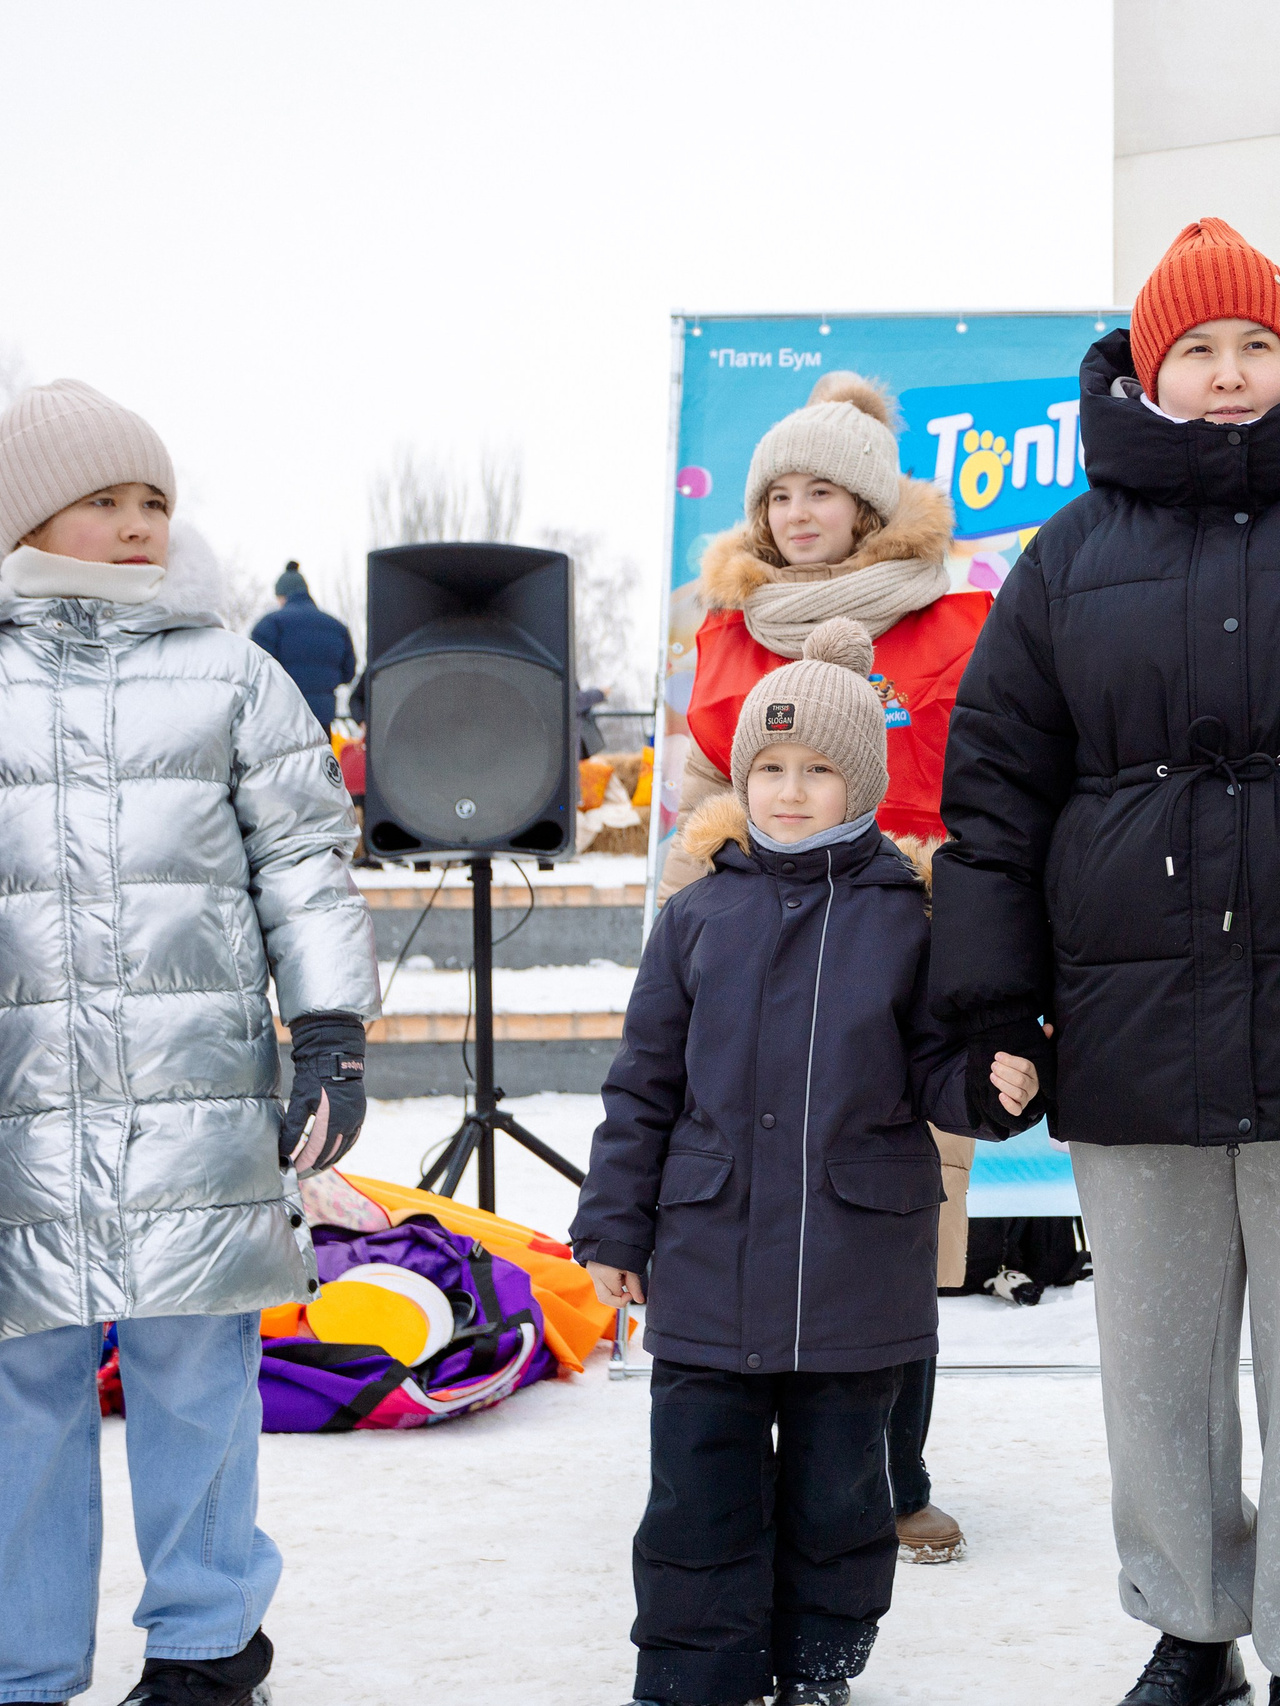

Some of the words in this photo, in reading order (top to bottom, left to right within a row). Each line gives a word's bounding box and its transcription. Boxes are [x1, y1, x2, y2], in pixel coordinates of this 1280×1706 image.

[778, 348, 822, 371] Бум
[926, 399, 1085, 511] ТопТ
[767, 716, 793, 725] SLOGAN
[884, 710, 907, 724] жка
